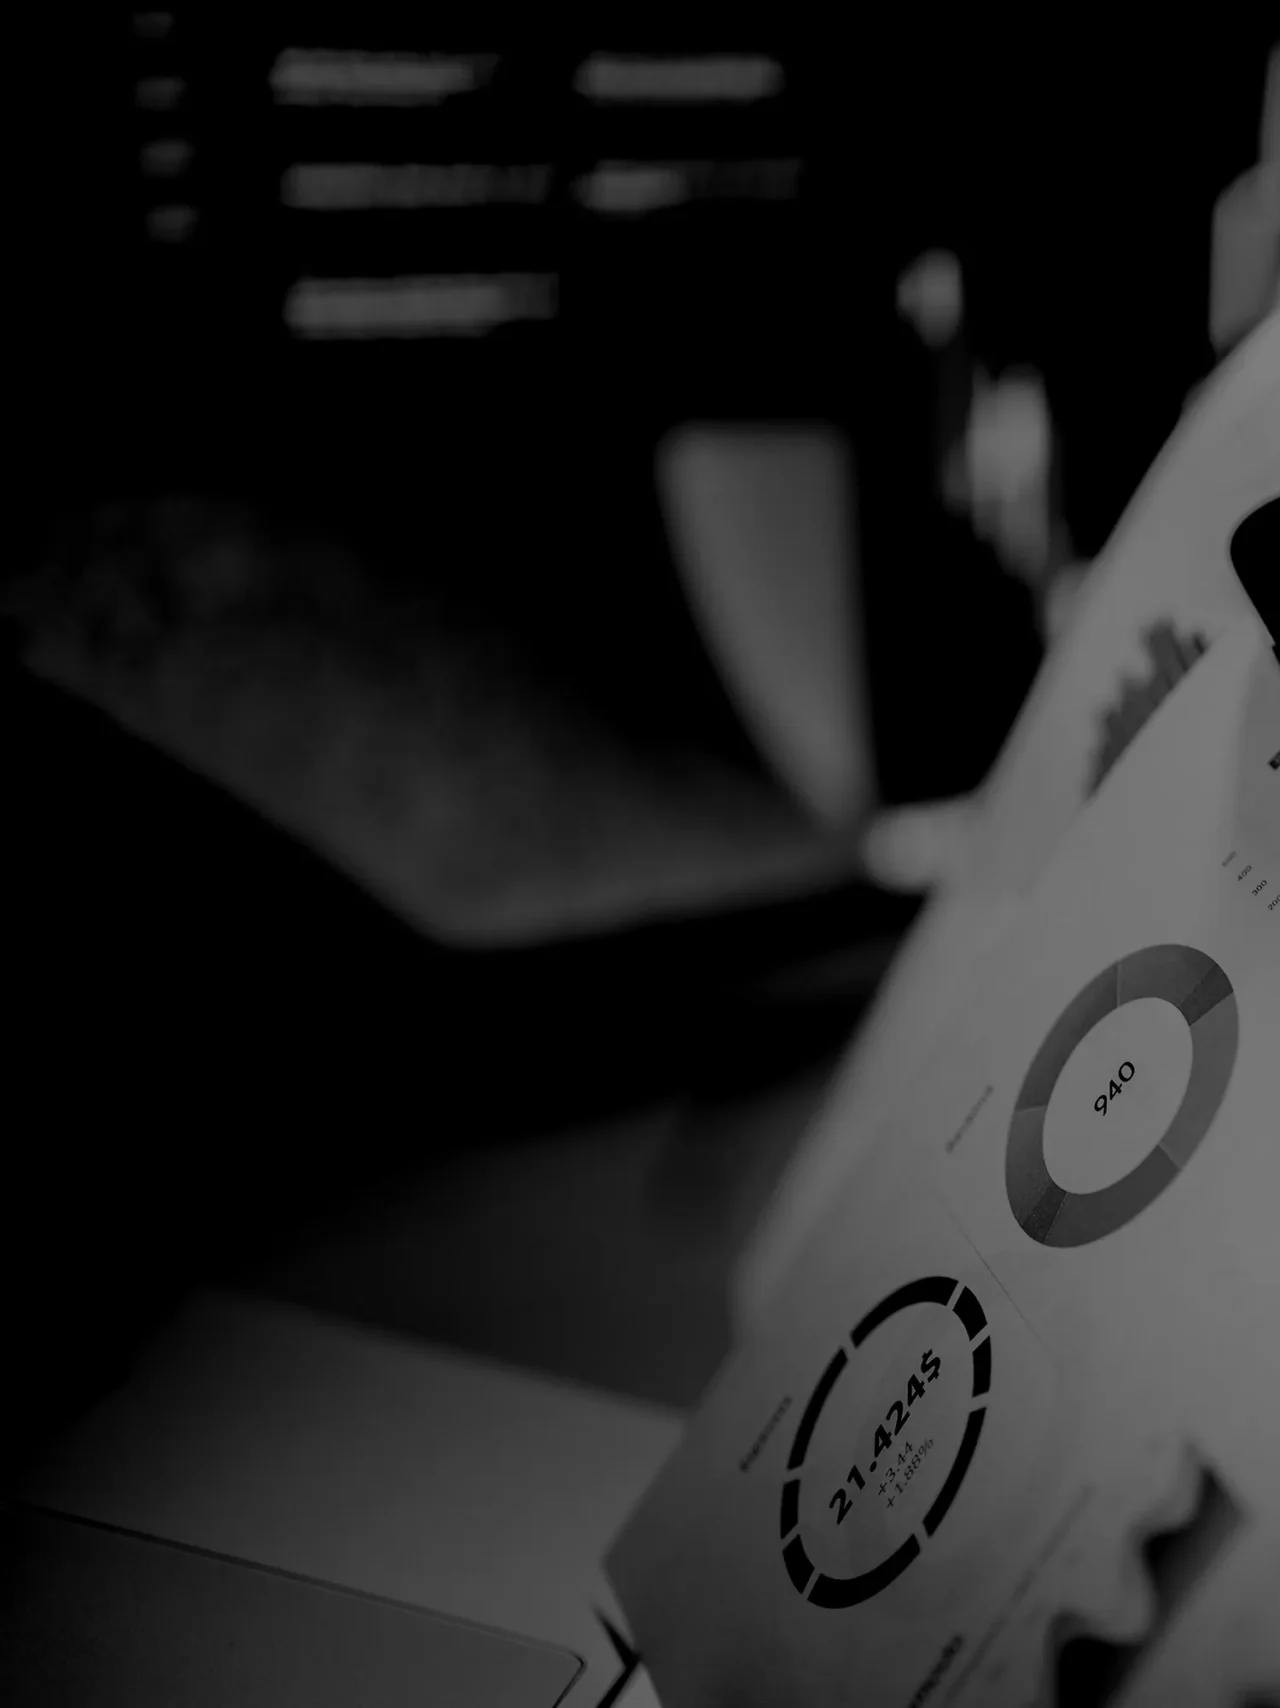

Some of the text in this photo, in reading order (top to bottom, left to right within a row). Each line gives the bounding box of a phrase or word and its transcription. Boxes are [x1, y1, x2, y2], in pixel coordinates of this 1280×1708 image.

[1237, 864, 1253, 882] 400
[1252, 880, 1268, 896] 300
[1093, 1061, 1135, 1117] 940
[828, 1348, 942, 1526] 21.424$
[877, 1441, 915, 1496] +3.44
